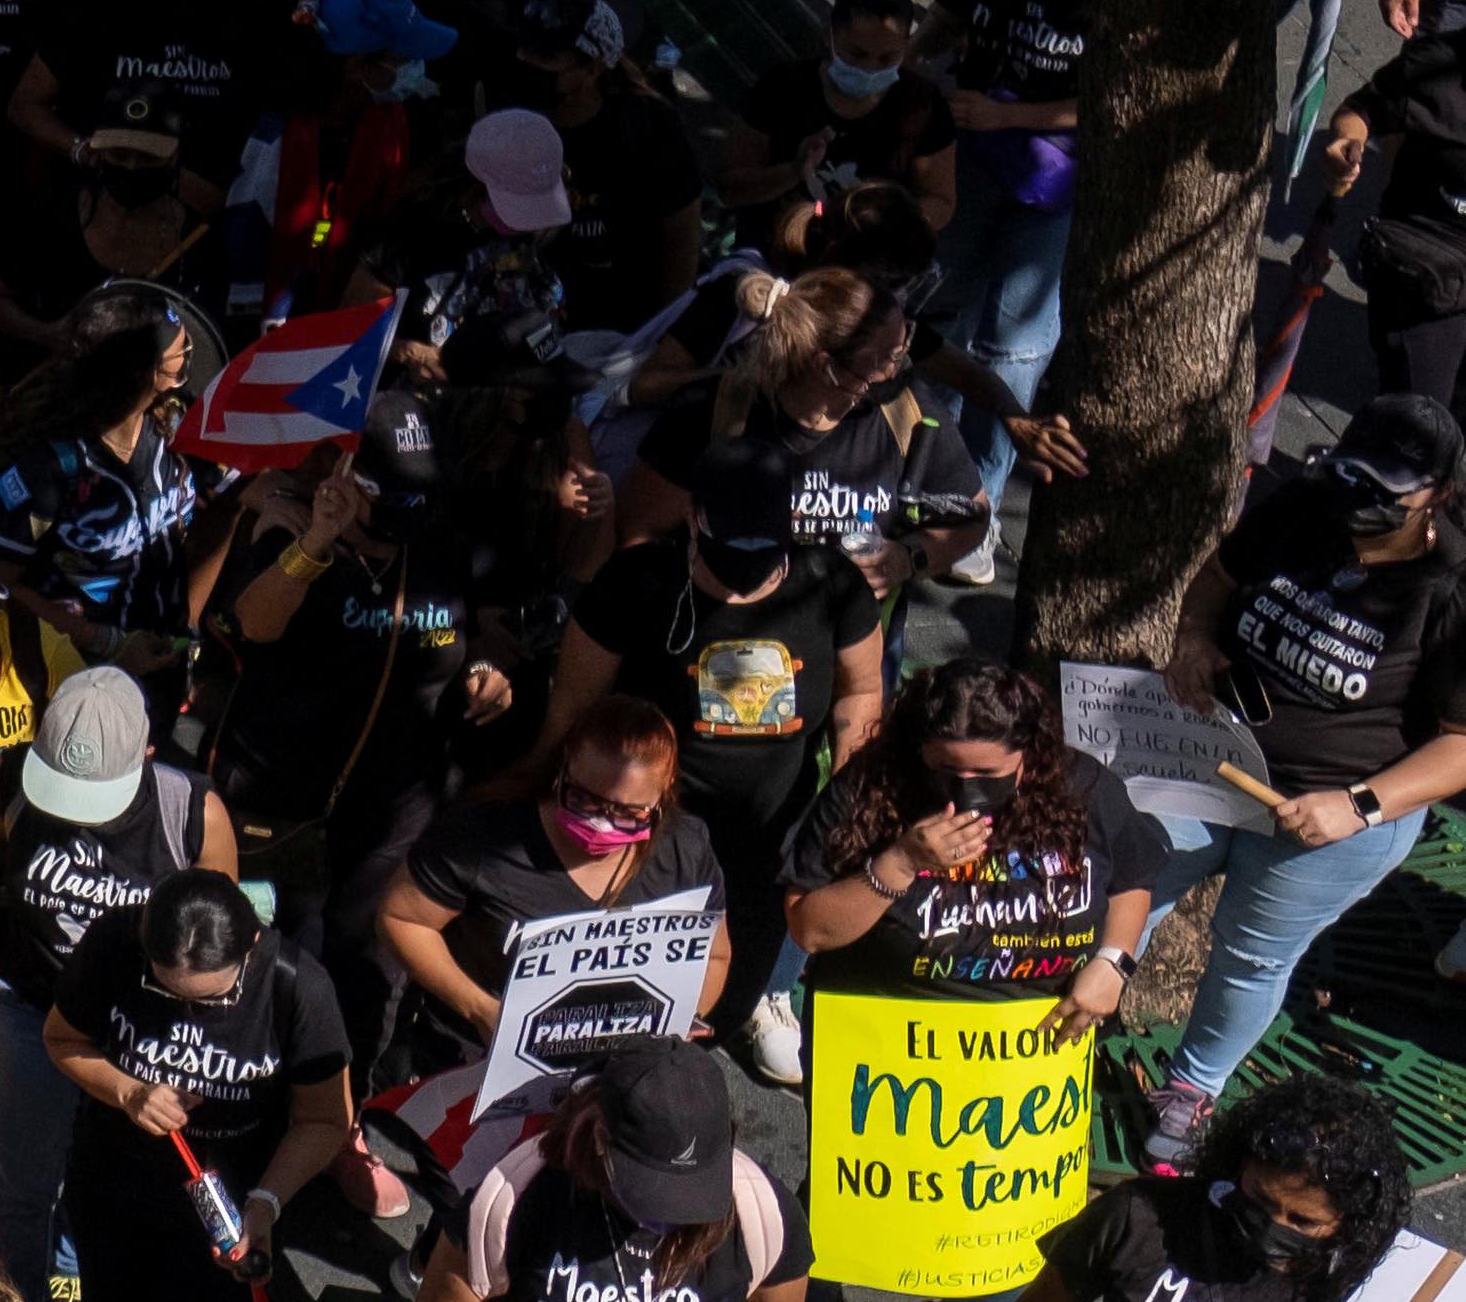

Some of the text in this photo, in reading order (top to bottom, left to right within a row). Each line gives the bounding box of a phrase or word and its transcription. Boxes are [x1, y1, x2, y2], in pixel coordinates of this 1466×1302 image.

[1254, 595, 1376, 669] QUE NOS QUITARON
[1238, 613, 1368, 699] EL MIEDO
[587, 914, 715, 943] MAESTROS
[515, 935, 707, 981] EL PAÍS SE
[110, 1008, 281, 1079] Maestros
[170, 1022, 205, 1043] SIN
[534, 1012, 654, 1042] PARALIZA
[958, 1026, 1060, 1062] VALOR
[838, 1157, 944, 1203] NO ES
